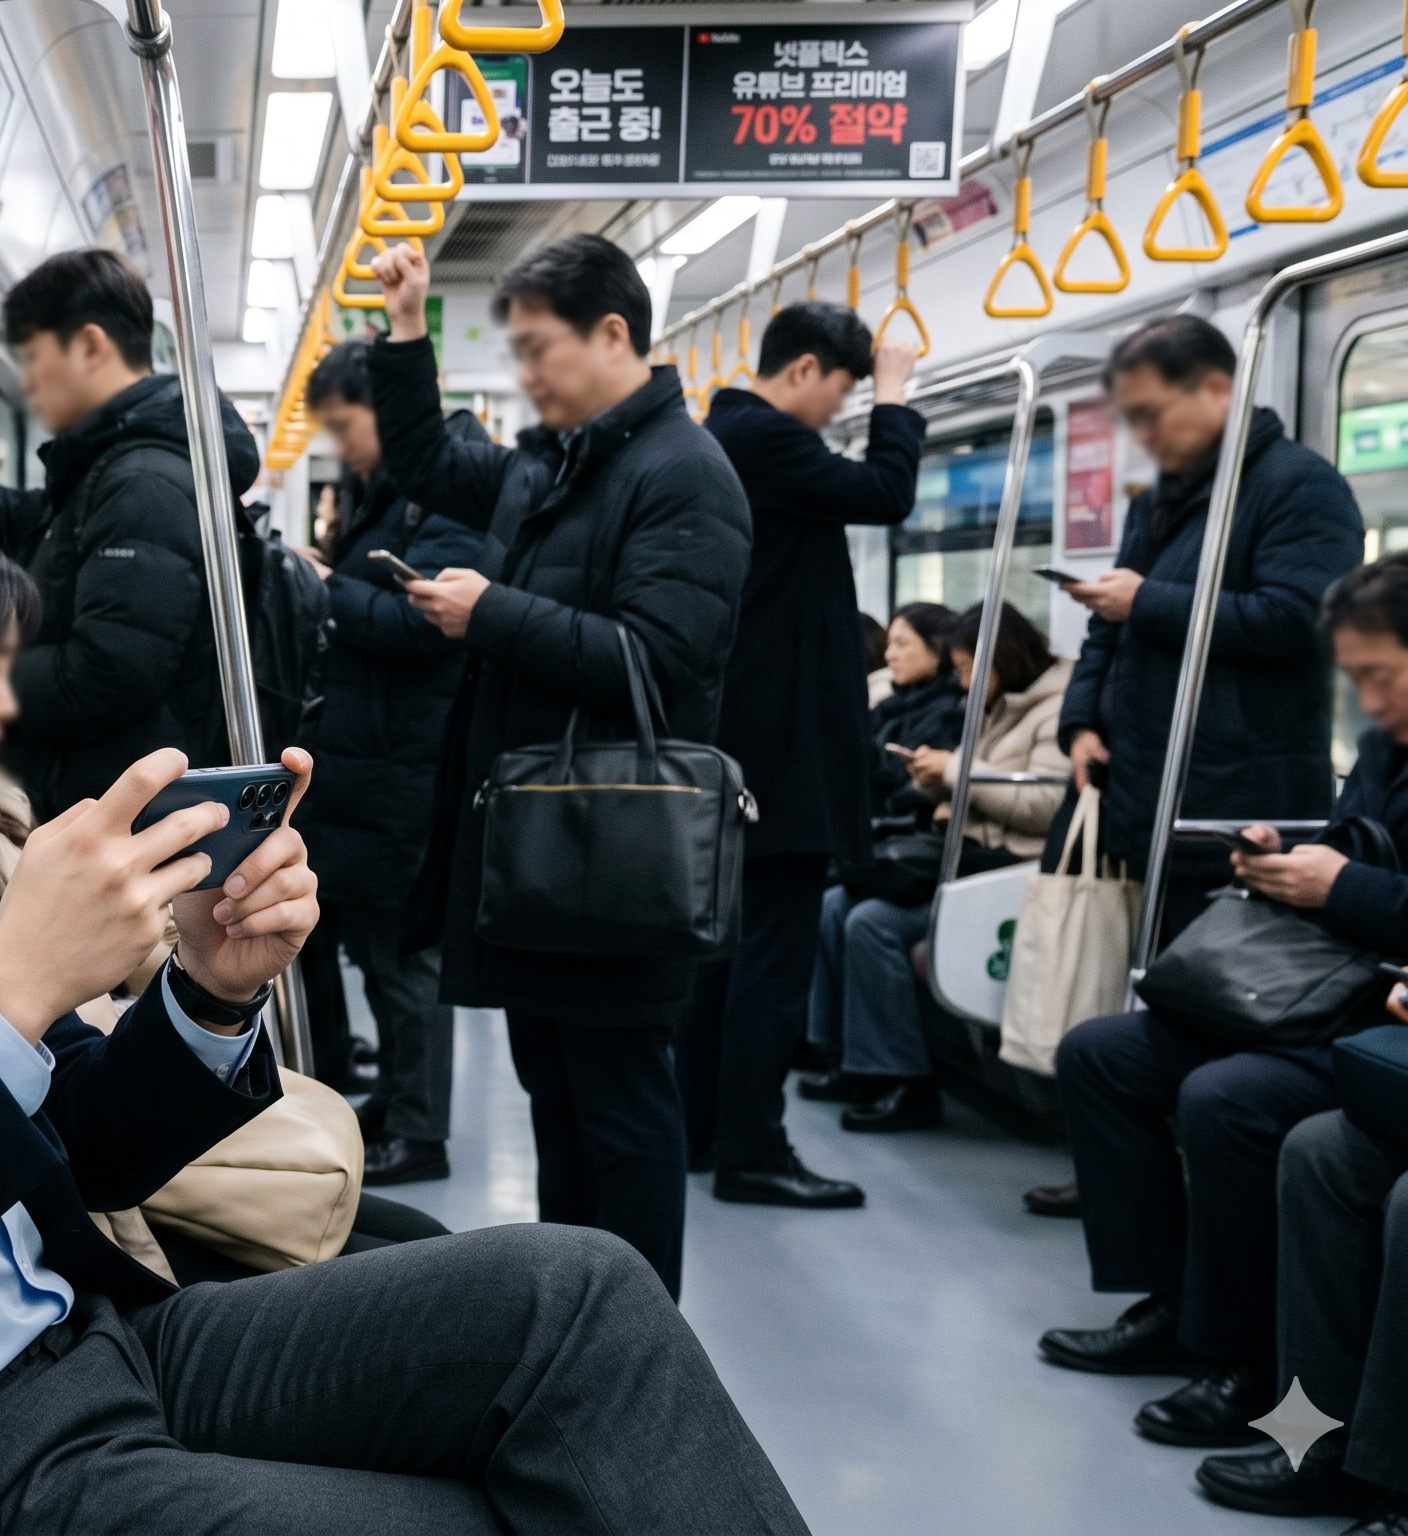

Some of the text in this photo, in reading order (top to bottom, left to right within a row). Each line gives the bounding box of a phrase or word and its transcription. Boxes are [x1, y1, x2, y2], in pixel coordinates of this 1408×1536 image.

[774, 40, 869, 67] 넷플릭스
[548, 68, 644, 102] 오늘도
[732, 70, 907, 100] 유튜브 프리미엄
[548, 106, 661, 142] 출근 중!
[730, 102, 908, 145] 70% 절약
